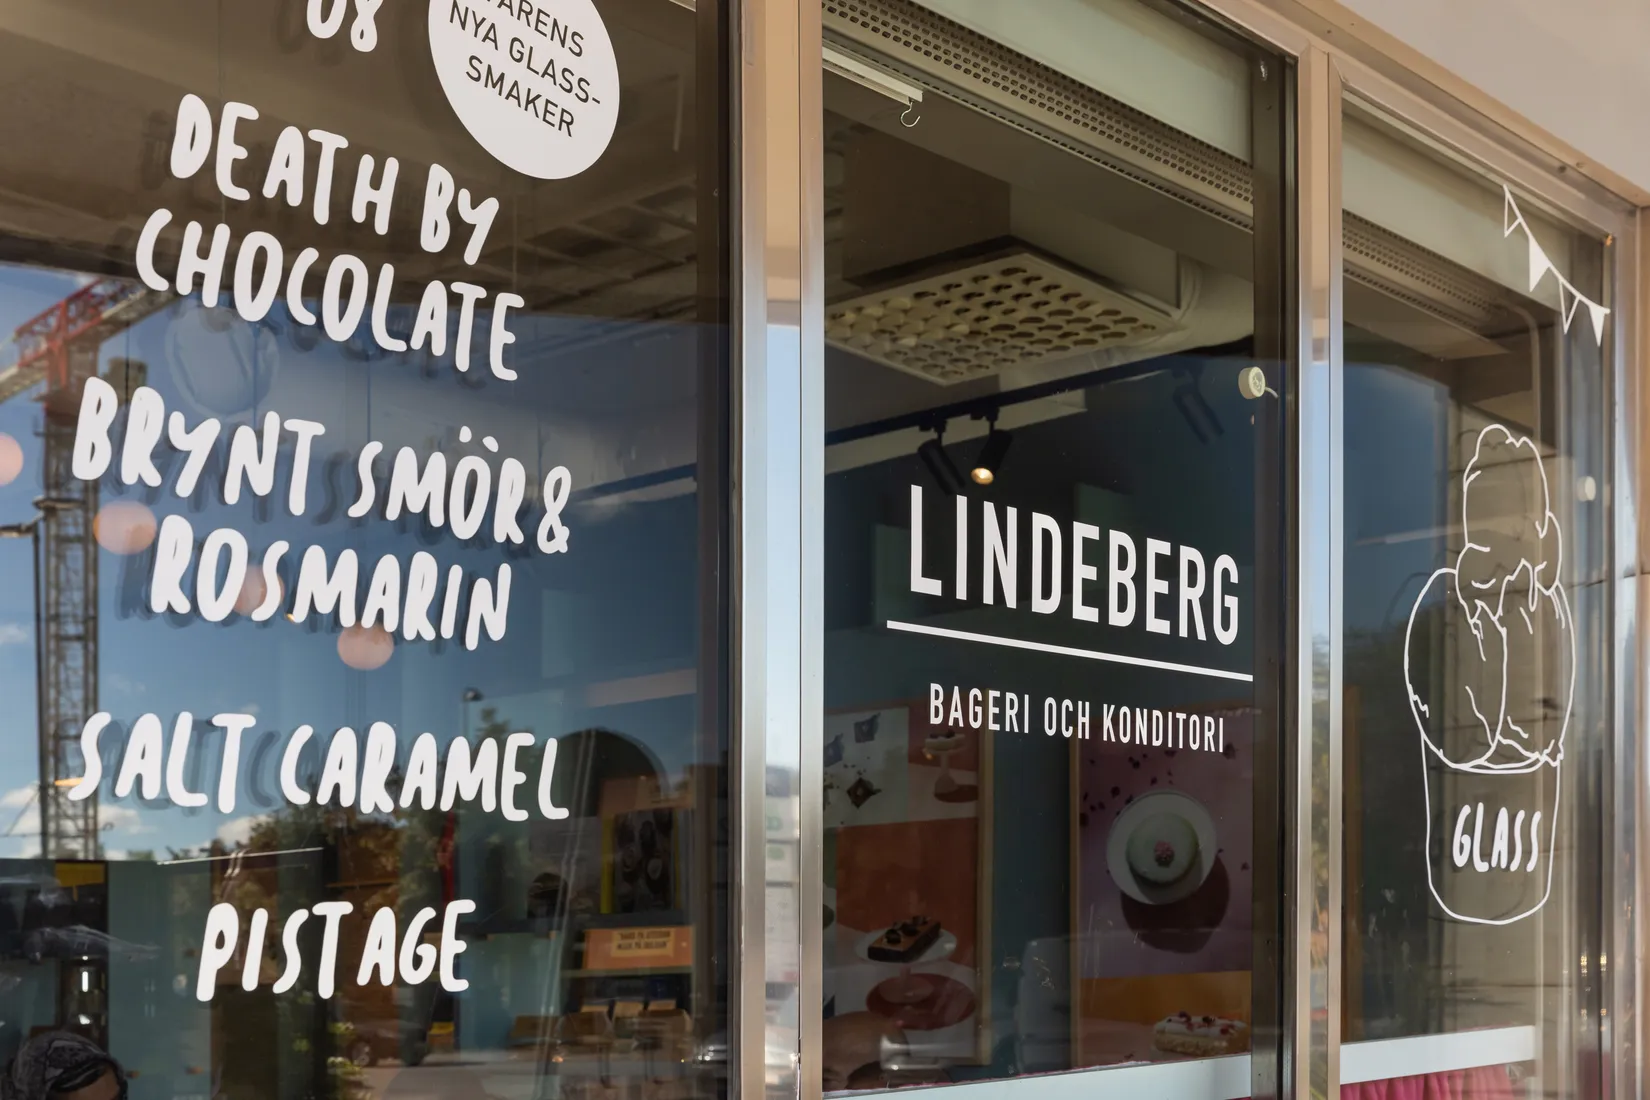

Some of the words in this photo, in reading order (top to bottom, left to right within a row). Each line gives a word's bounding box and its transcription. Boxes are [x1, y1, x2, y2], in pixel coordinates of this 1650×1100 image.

[449, 0, 499, 51] NYA
[509, 36, 601, 105] GLASS-
[465, 54, 576, 138] SMAKER
[170, 93, 399, 235] DEATH
[420, 163, 500, 266] BY
[135, 208, 525, 381] CHOCOLATE
[71, 376, 326, 516] BRYNT
[347, 425, 526, 544] SMÖR
[537, 465, 572, 554] &
[150, 514, 512, 651] ROSMARIN
[910, 484, 1239, 646] LINDEBERG
[66, 711, 257, 815] SALT
[280, 721, 570, 822] CARAMEL
[929, 683, 1030, 734] BAGERI
[1044, 697, 1091, 740] OCH
[1103, 703, 1225, 753] KONDITORI
[1452, 802, 1542, 873] GLASS
[196, 899, 476, 1002] PISTAGE
